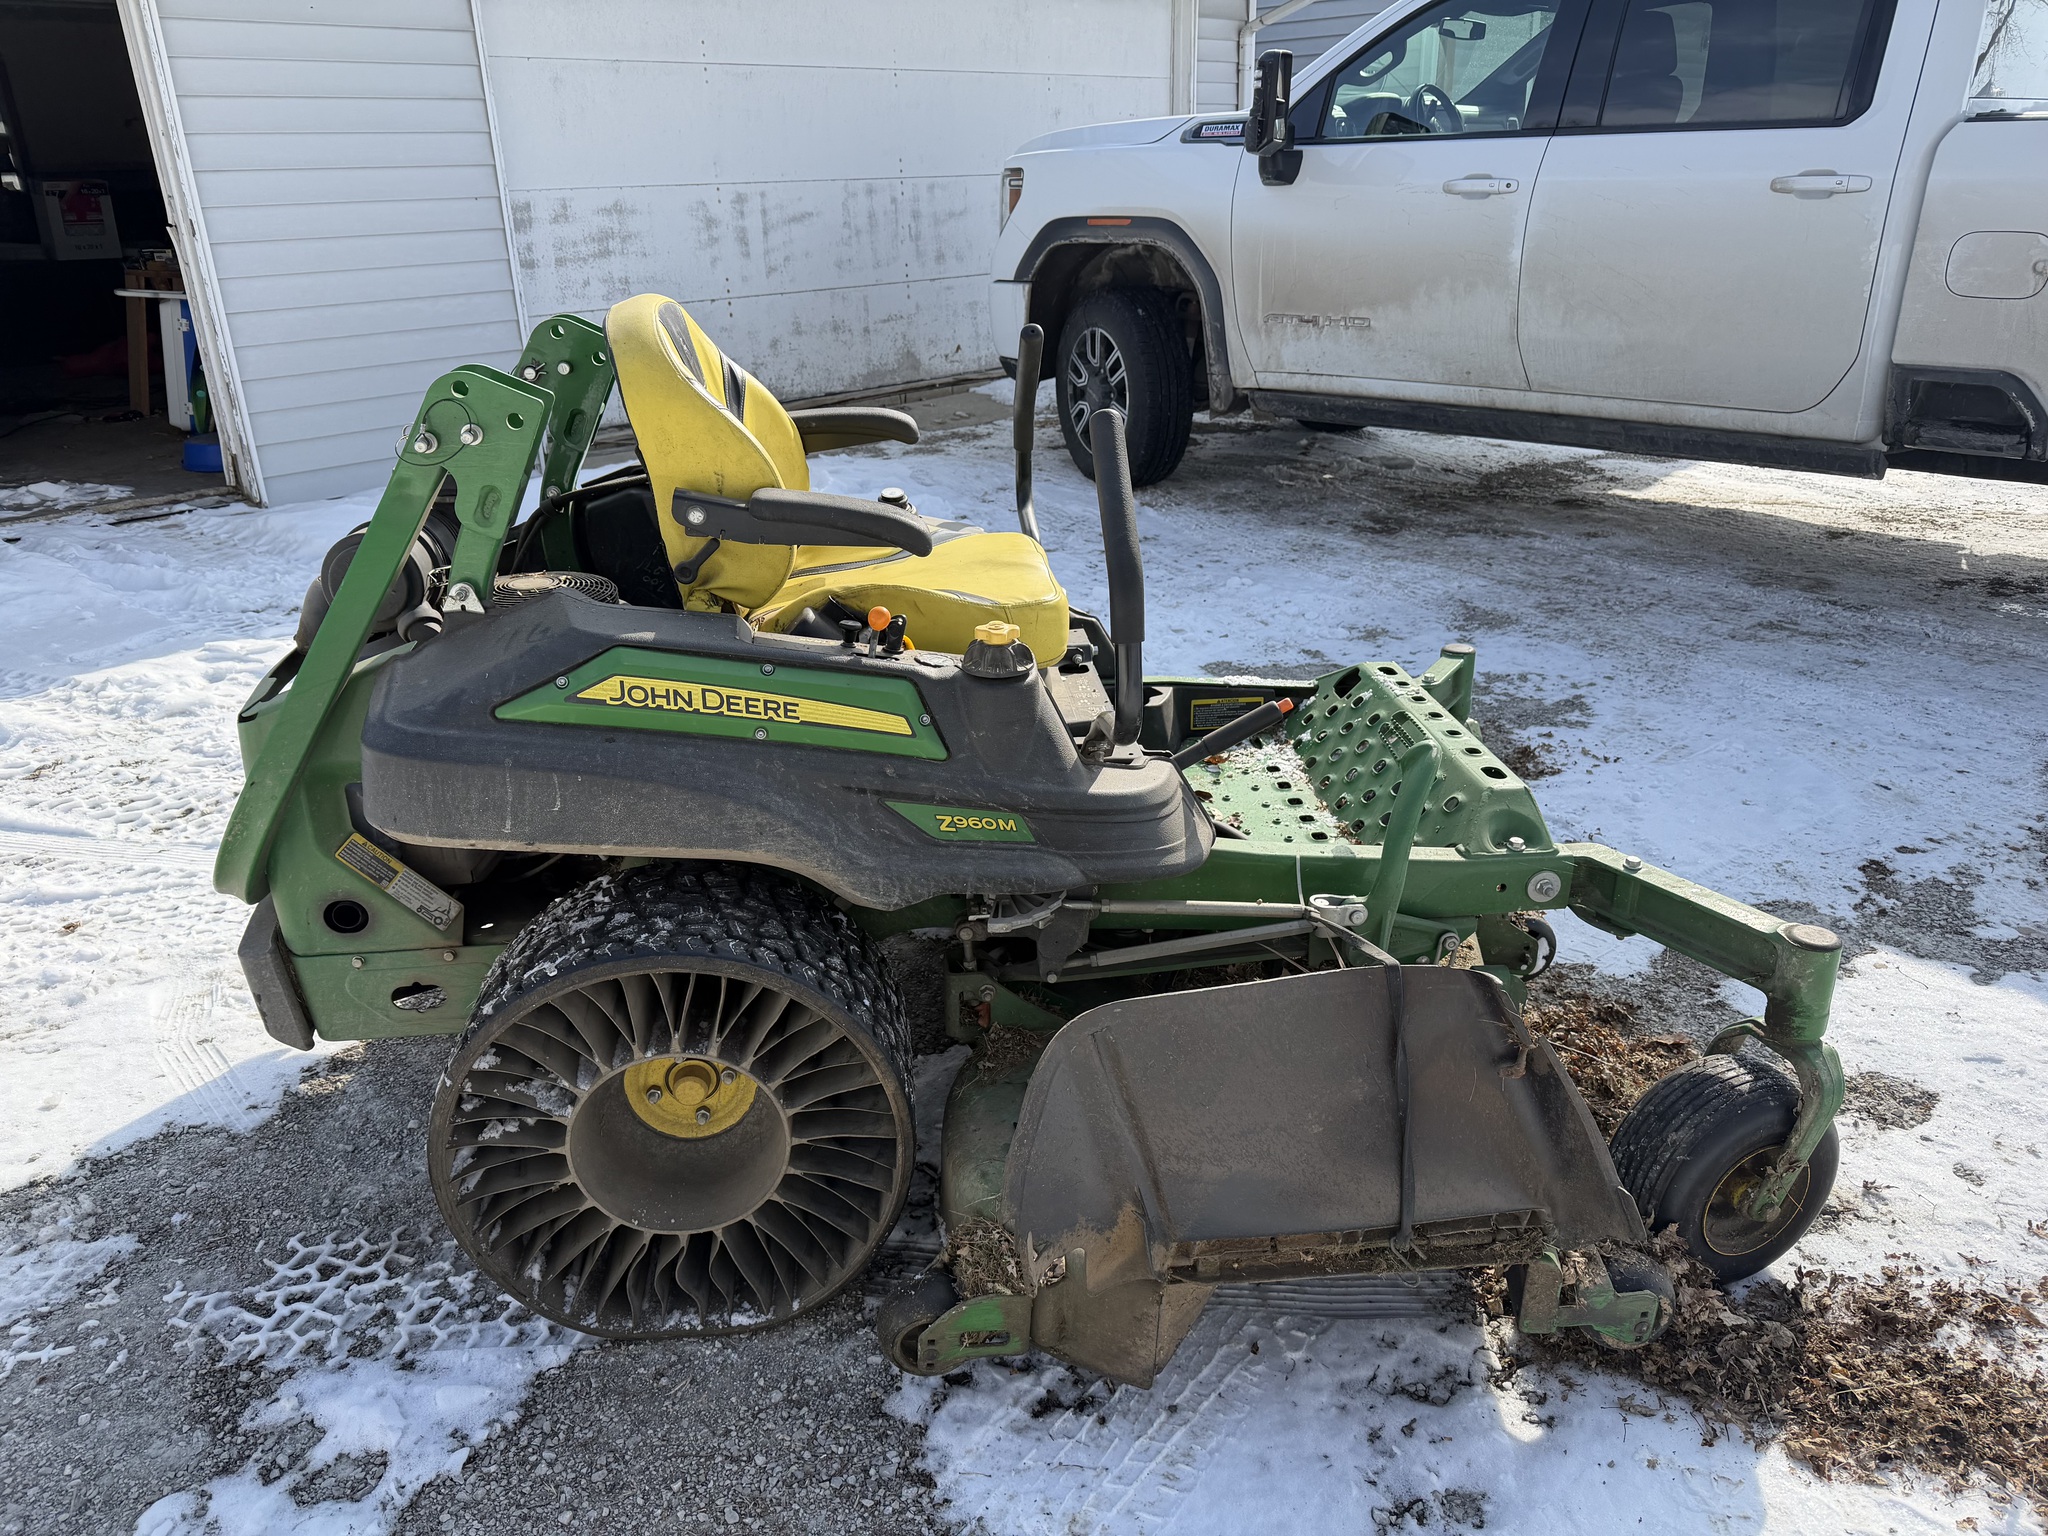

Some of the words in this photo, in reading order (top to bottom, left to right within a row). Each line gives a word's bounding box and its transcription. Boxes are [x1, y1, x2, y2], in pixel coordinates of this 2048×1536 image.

[1204, 124, 1241, 132] DURAMAX
[1325, 315, 1371, 328] HD
[607, 680, 693, 709] JOHN
[702, 688, 800, 720] DEERE
[935, 815, 1017, 832] Z960M
[367, 844, 392, 864] CAUTION
